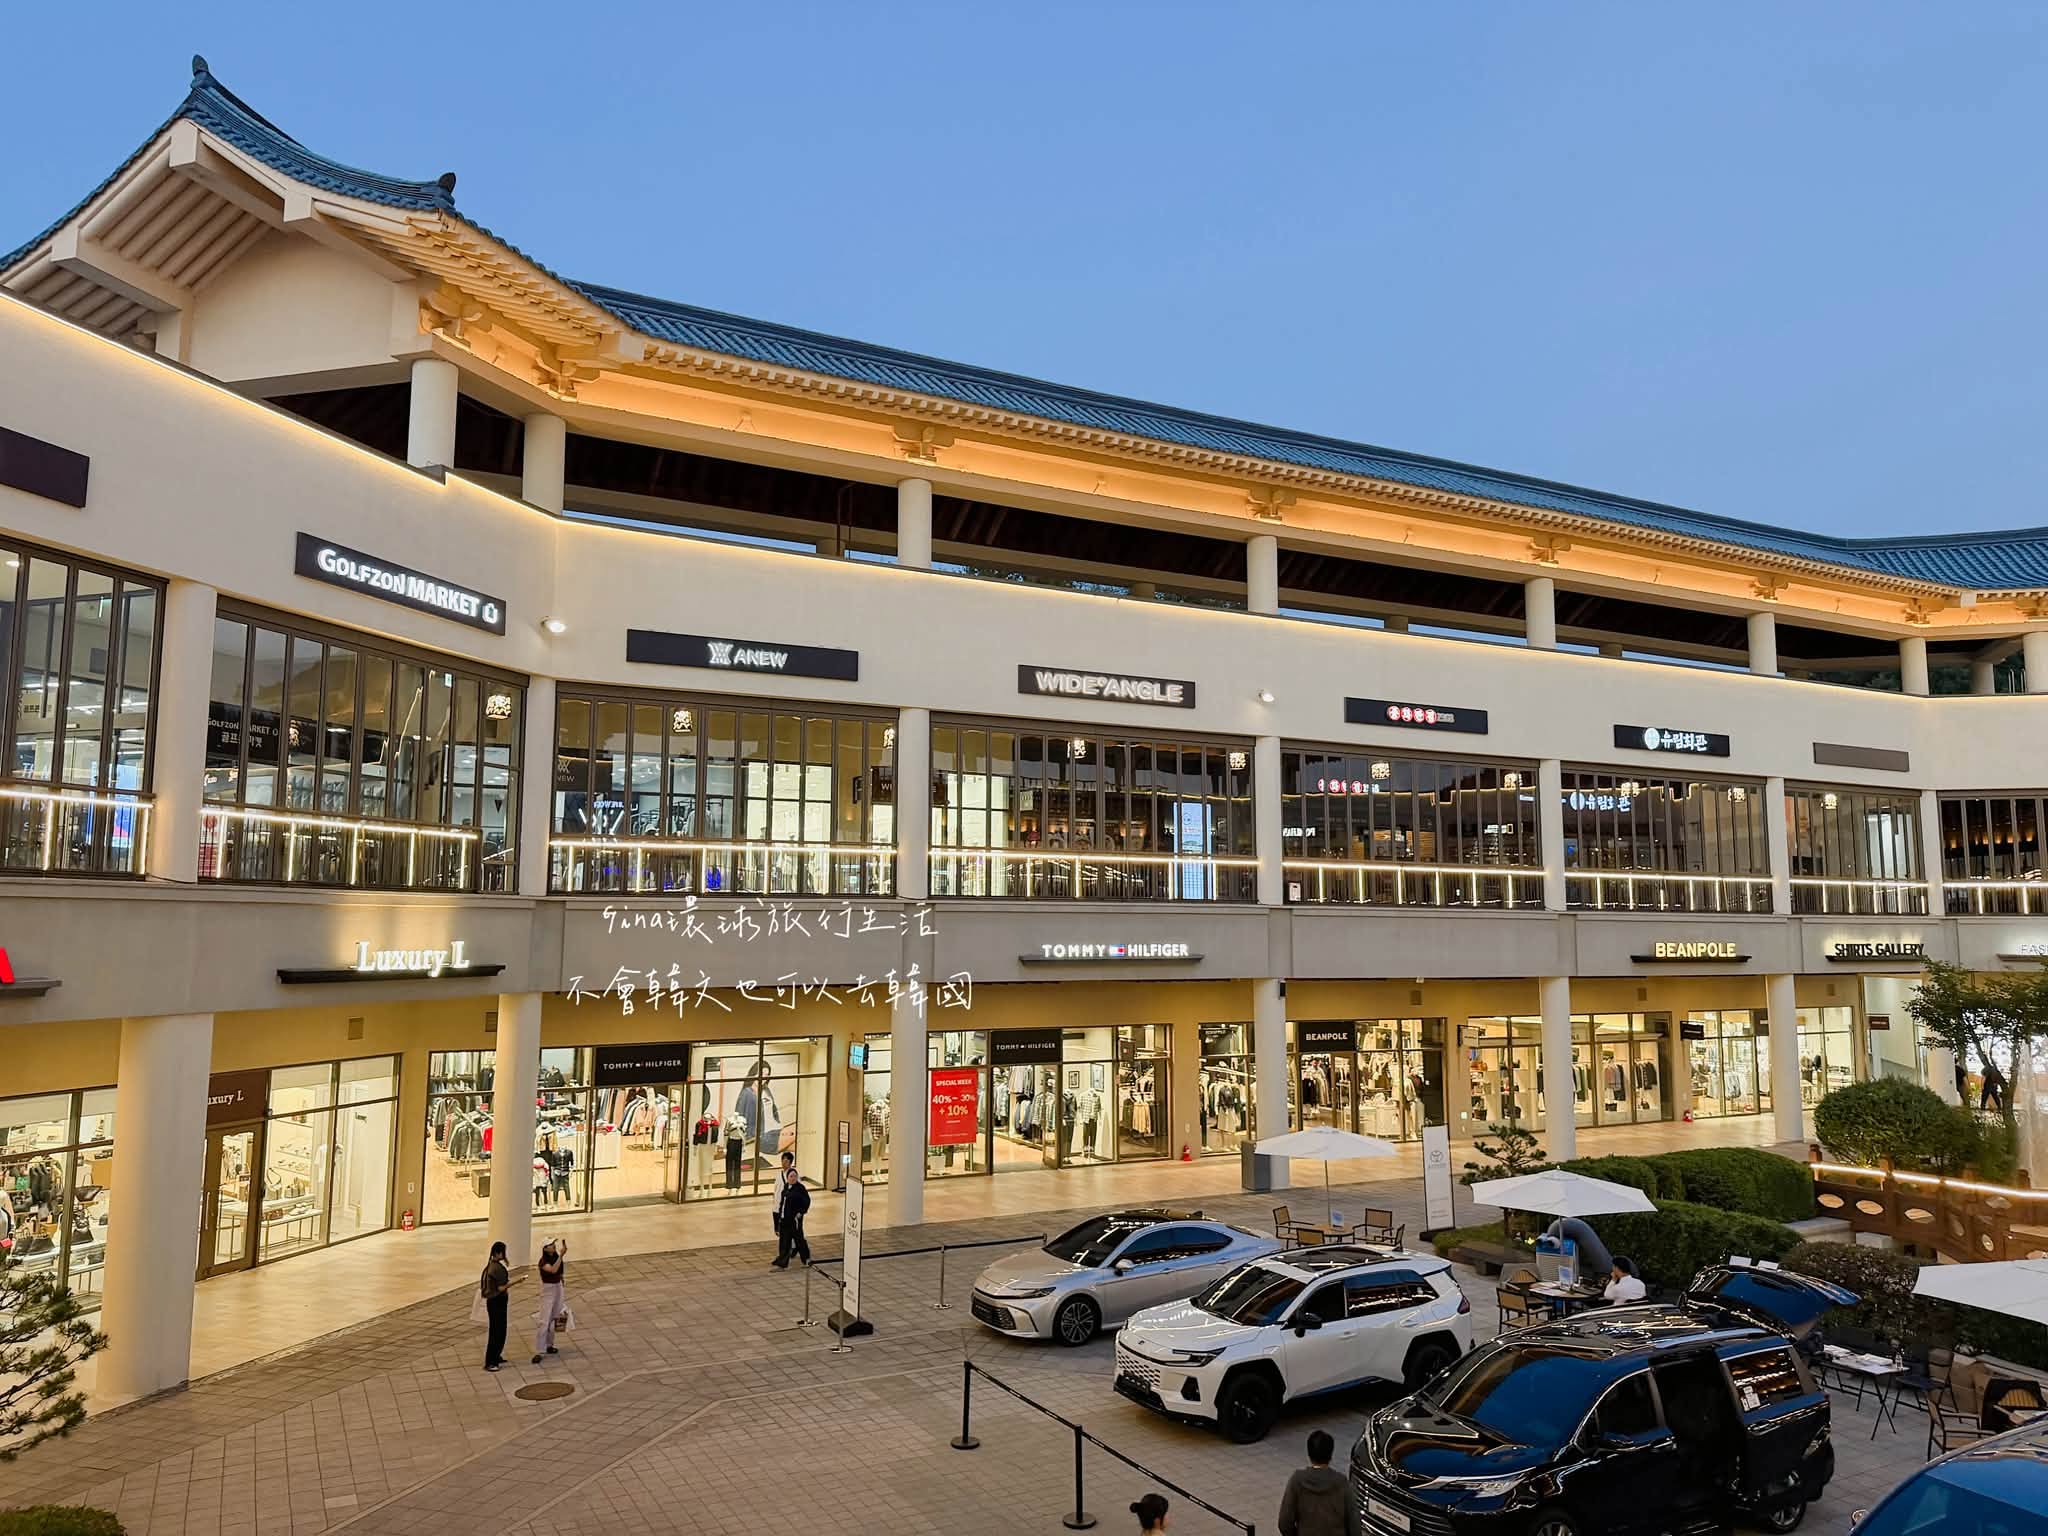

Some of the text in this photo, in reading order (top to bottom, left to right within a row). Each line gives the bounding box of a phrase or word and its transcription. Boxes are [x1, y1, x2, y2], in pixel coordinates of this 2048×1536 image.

[733, 648, 788, 669] ANEW
[1042, 943, 1189, 958] TOMMY HILFIGER
[1655, 942, 1737, 958] BEANPOLE
[1834, 943, 1925, 957] SHIRTS GALLERY
[356, 940, 470, 977] Luxury L
[1305, 1032, 1348, 1041] BEANPOLE
[645, 1060, 682, 1068] HILFIGER
[237, 1090, 244, 1101] L
[947, 1104, 969, 1116] 10%
